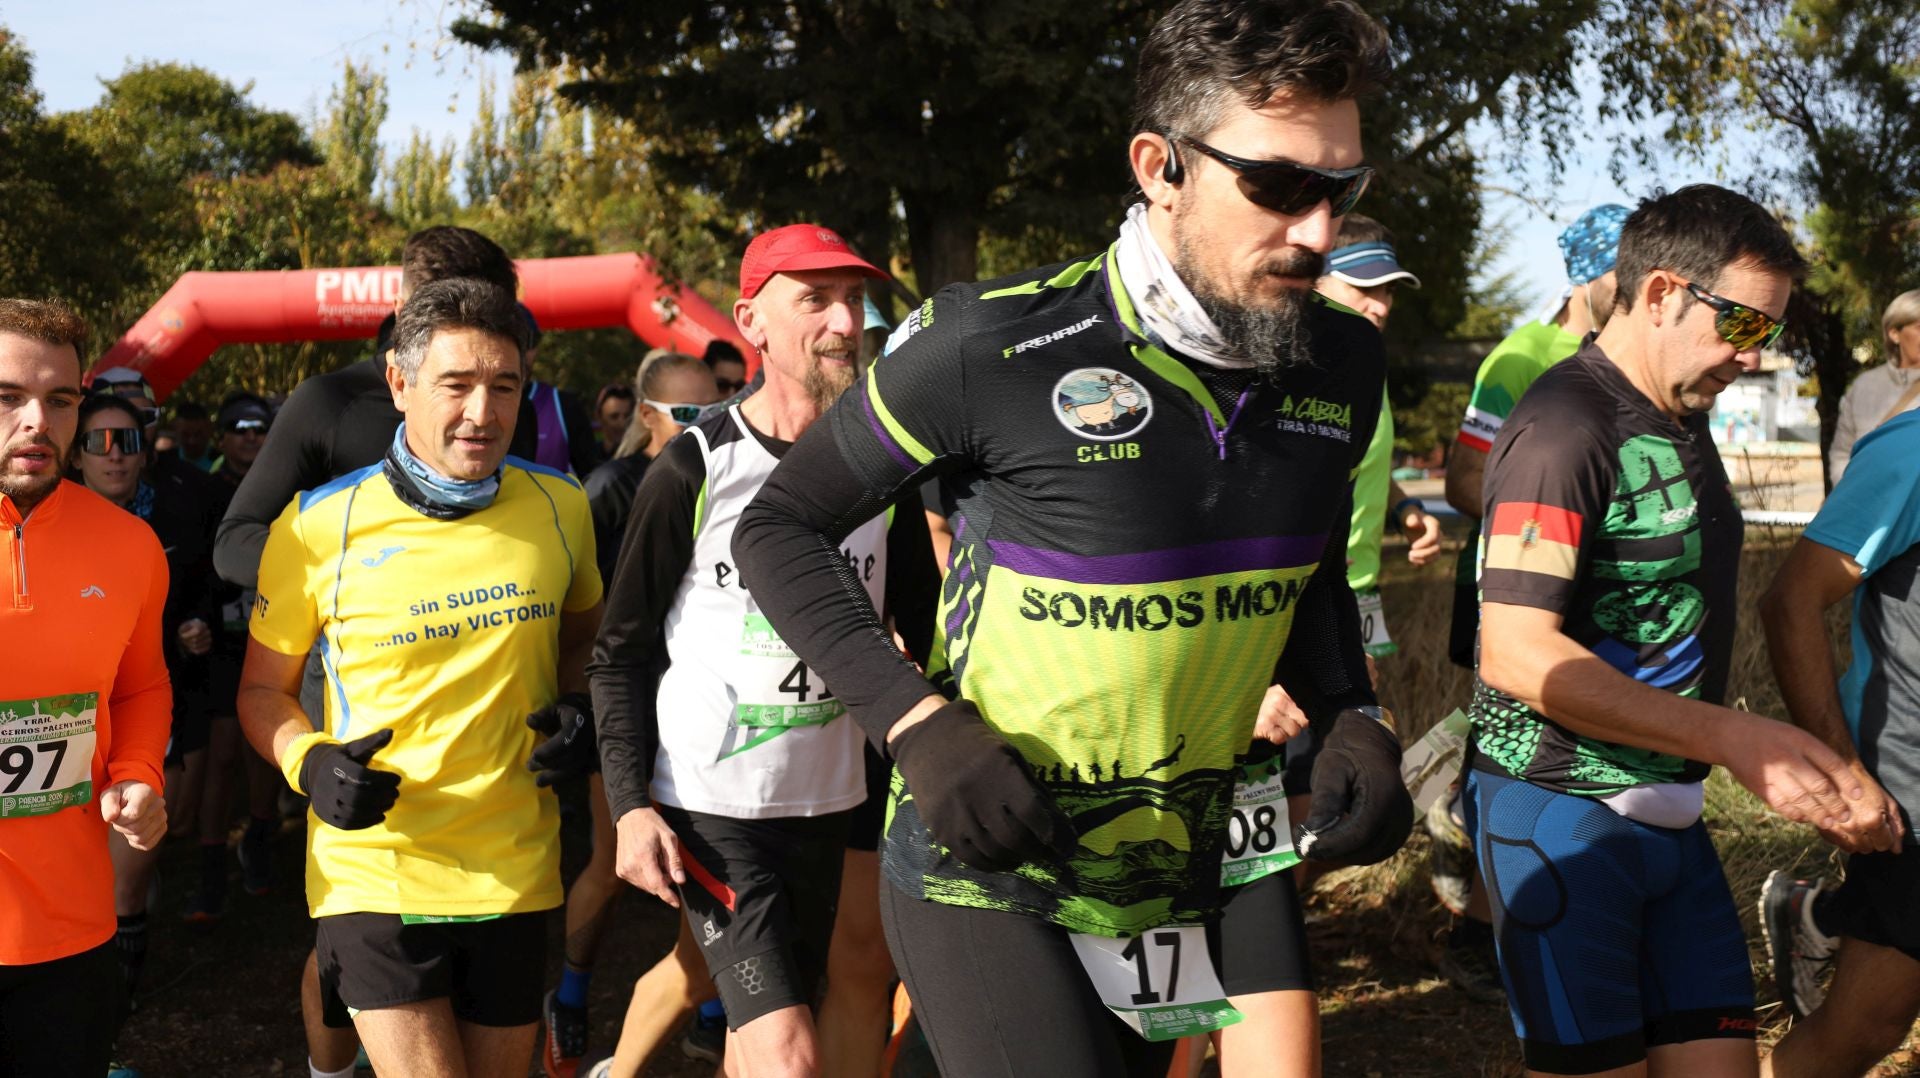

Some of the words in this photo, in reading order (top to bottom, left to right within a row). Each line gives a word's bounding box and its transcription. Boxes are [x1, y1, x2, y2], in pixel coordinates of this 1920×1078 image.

[1002, 314, 1104, 359] FIREHAWK
[1295, 396, 1352, 431] CABRA
[1076, 442, 1141, 463] CLUB
[410, 599, 440, 617] sin
[446, 582, 536, 609] SUDOR...
[1019, 586, 1205, 633] SOMOS
[374, 630, 418, 648] ...no
[424, 621, 461, 639] hay
[467, 601, 556, 632] VICTORIA
[0, 727, 40, 737] CERROS
[42, 718, 93, 733] PALENTINOS
[24, 716, 52, 726] TRAIL
[0, 739, 68, 794] 97
[1224, 805, 1277, 859] 08
[1121, 931, 1181, 1006] 17
